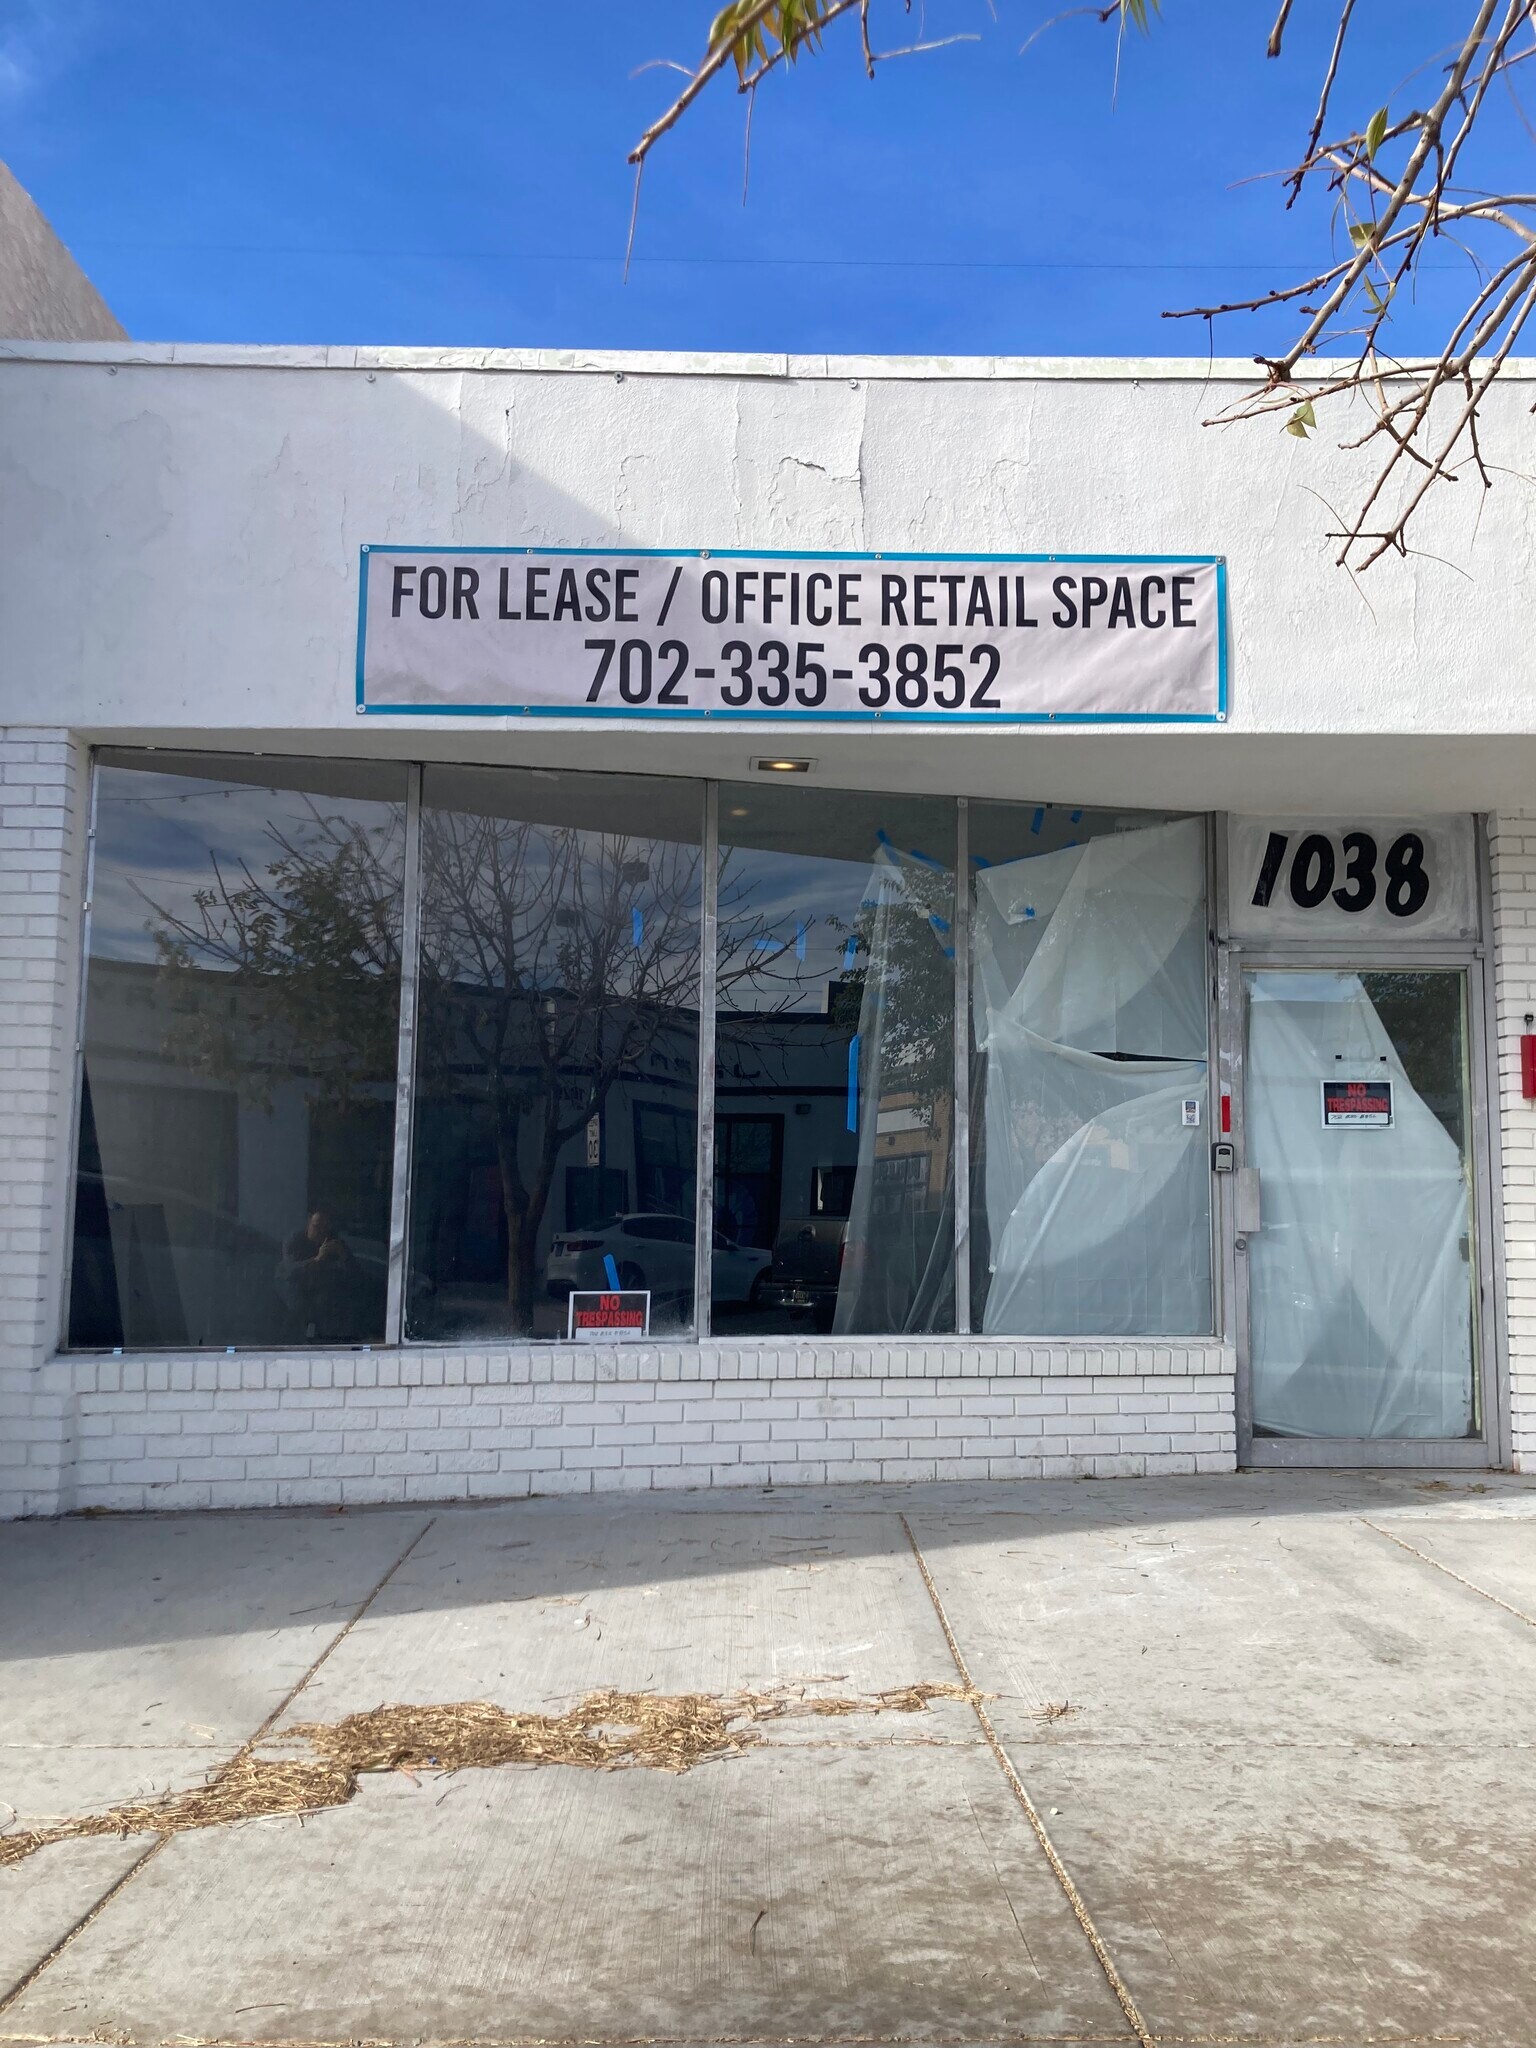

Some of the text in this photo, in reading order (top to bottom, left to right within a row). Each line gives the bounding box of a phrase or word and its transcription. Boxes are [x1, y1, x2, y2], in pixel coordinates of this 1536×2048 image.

[391, 565, 1197, 629] FOR LEASE / OFFICE RETAIL SPACE
[584, 638, 1001, 709] 702-335-3852
[1251, 831, 1430, 917] 1038
[1347, 1083, 1367, 1097] NO
[1327, 1097, 1389, 1112] TRESPASSING
[600, 1294, 621, 1311] NO
[576, 1311, 643, 1327] TRESPASSING
